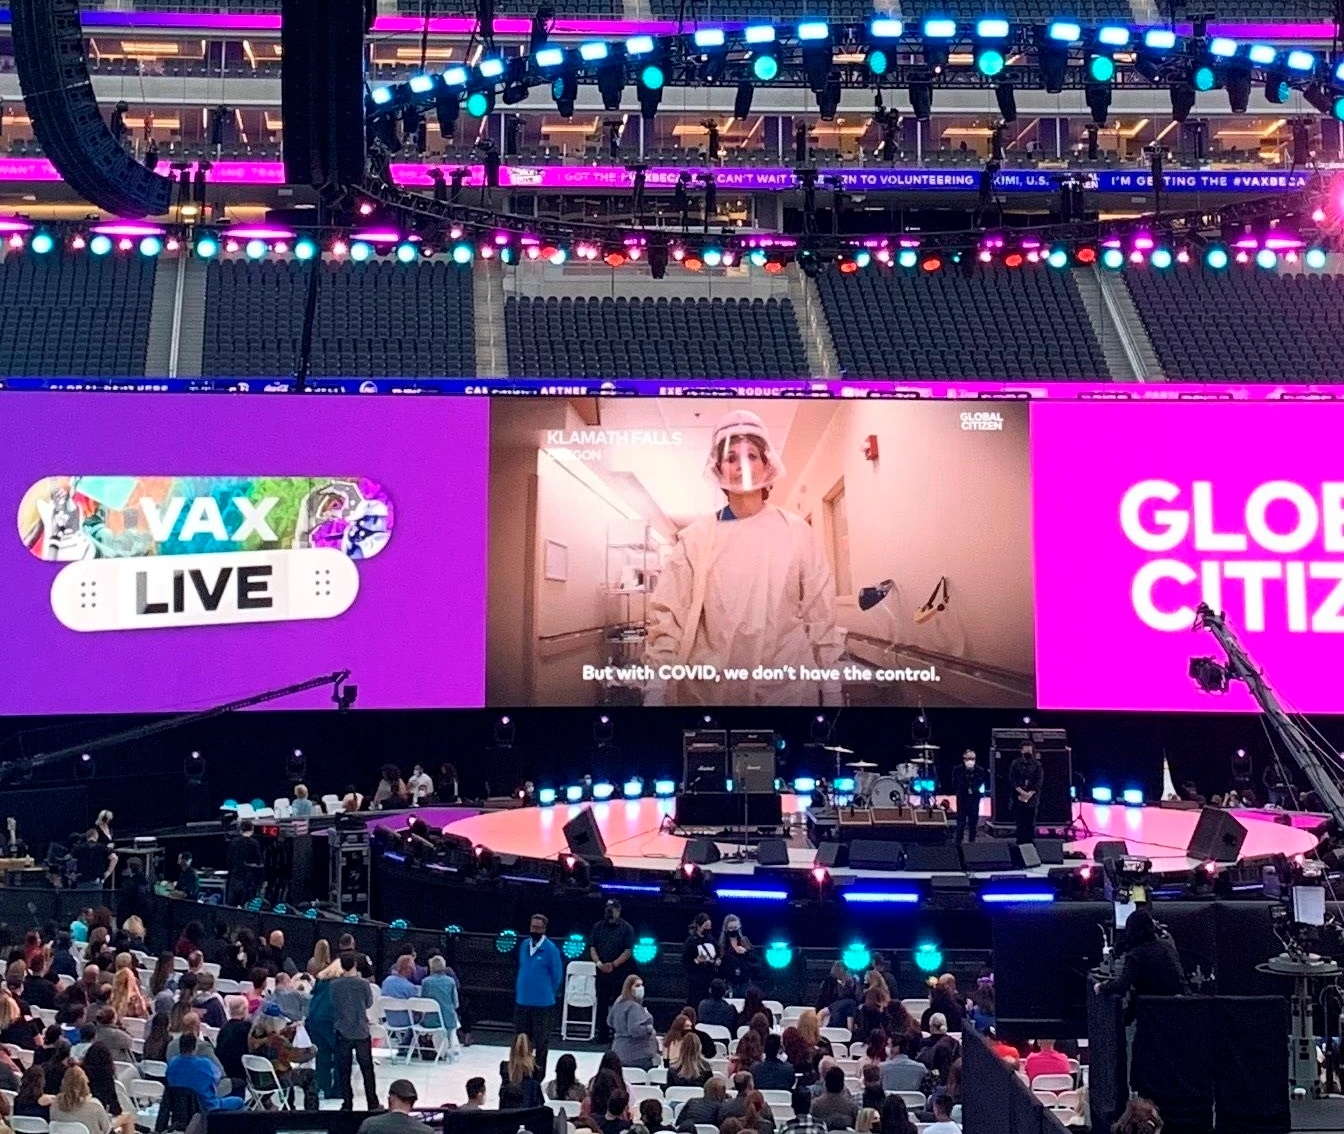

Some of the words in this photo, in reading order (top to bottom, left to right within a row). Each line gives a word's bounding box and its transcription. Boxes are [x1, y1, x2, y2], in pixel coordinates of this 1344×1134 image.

[717, 173, 754, 185] CAN'T
[756, 174, 789, 185] WAIT
[859, 174, 877, 185] TO
[879, 174, 974, 186] VOLUNTEERING
[1026, 175, 1050, 186] U.S.
[1111, 176, 1132, 187] I'M
[1136, 176, 1197, 187] GETING
[1200, 176, 1228, 187] THE
[960, 412, 1004, 422] GLOBAL
[960, 421, 1003, 431] CITIZEN
[547, 430, 629, 445] KLAMATH
[631, 430, 684, 446] FALLS
[138, 496, 278, 542] VAX
[135, 565, 274, 616] LIVE
[582, 664, 614, 681] But
[616, 663, 655, 680] with
[658, 665, 721, 683] COVID,
[724, 669, 749, 681] we
[752, 663, 797, 681] don't
[800, 665, 842, 681] have
[843, 664, 873, 681] the
[875, 664, 941, 683] control.
